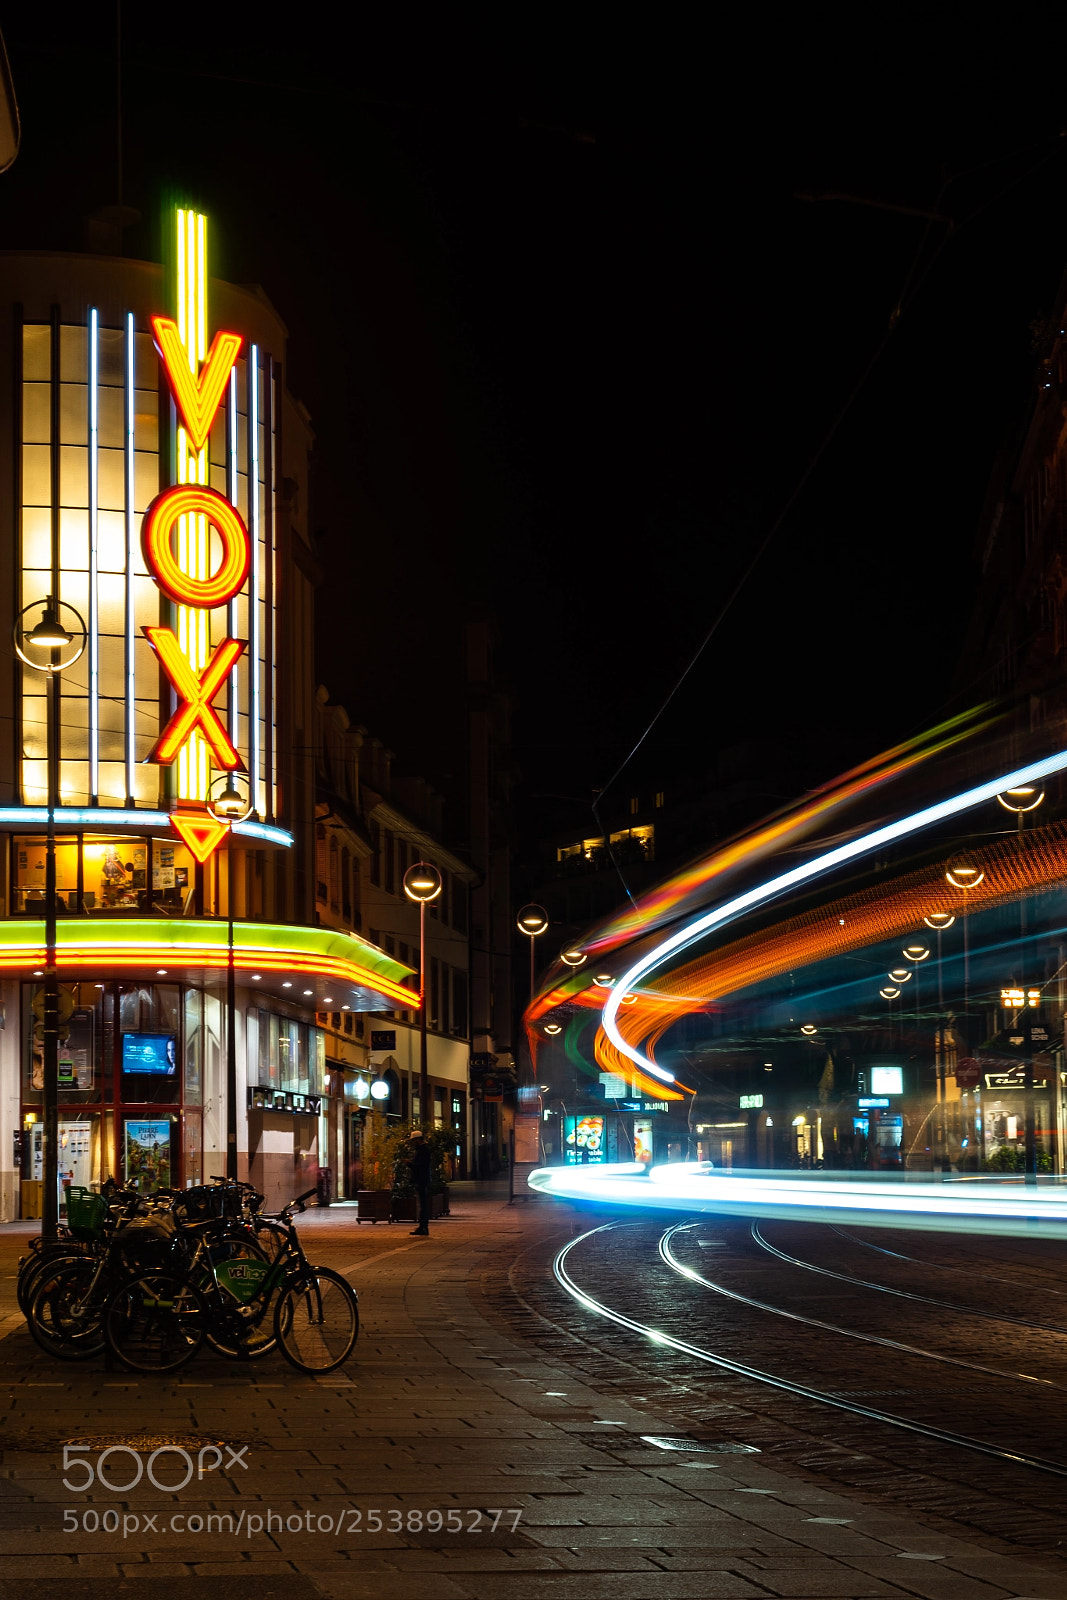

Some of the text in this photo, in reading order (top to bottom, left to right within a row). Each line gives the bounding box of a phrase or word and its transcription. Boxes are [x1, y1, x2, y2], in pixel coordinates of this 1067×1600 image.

[140, 314, 250, 773] VOX
[138, 1126, 159, 1134] PIERRE
[140, 1133, 157, 1141] LAPIN
